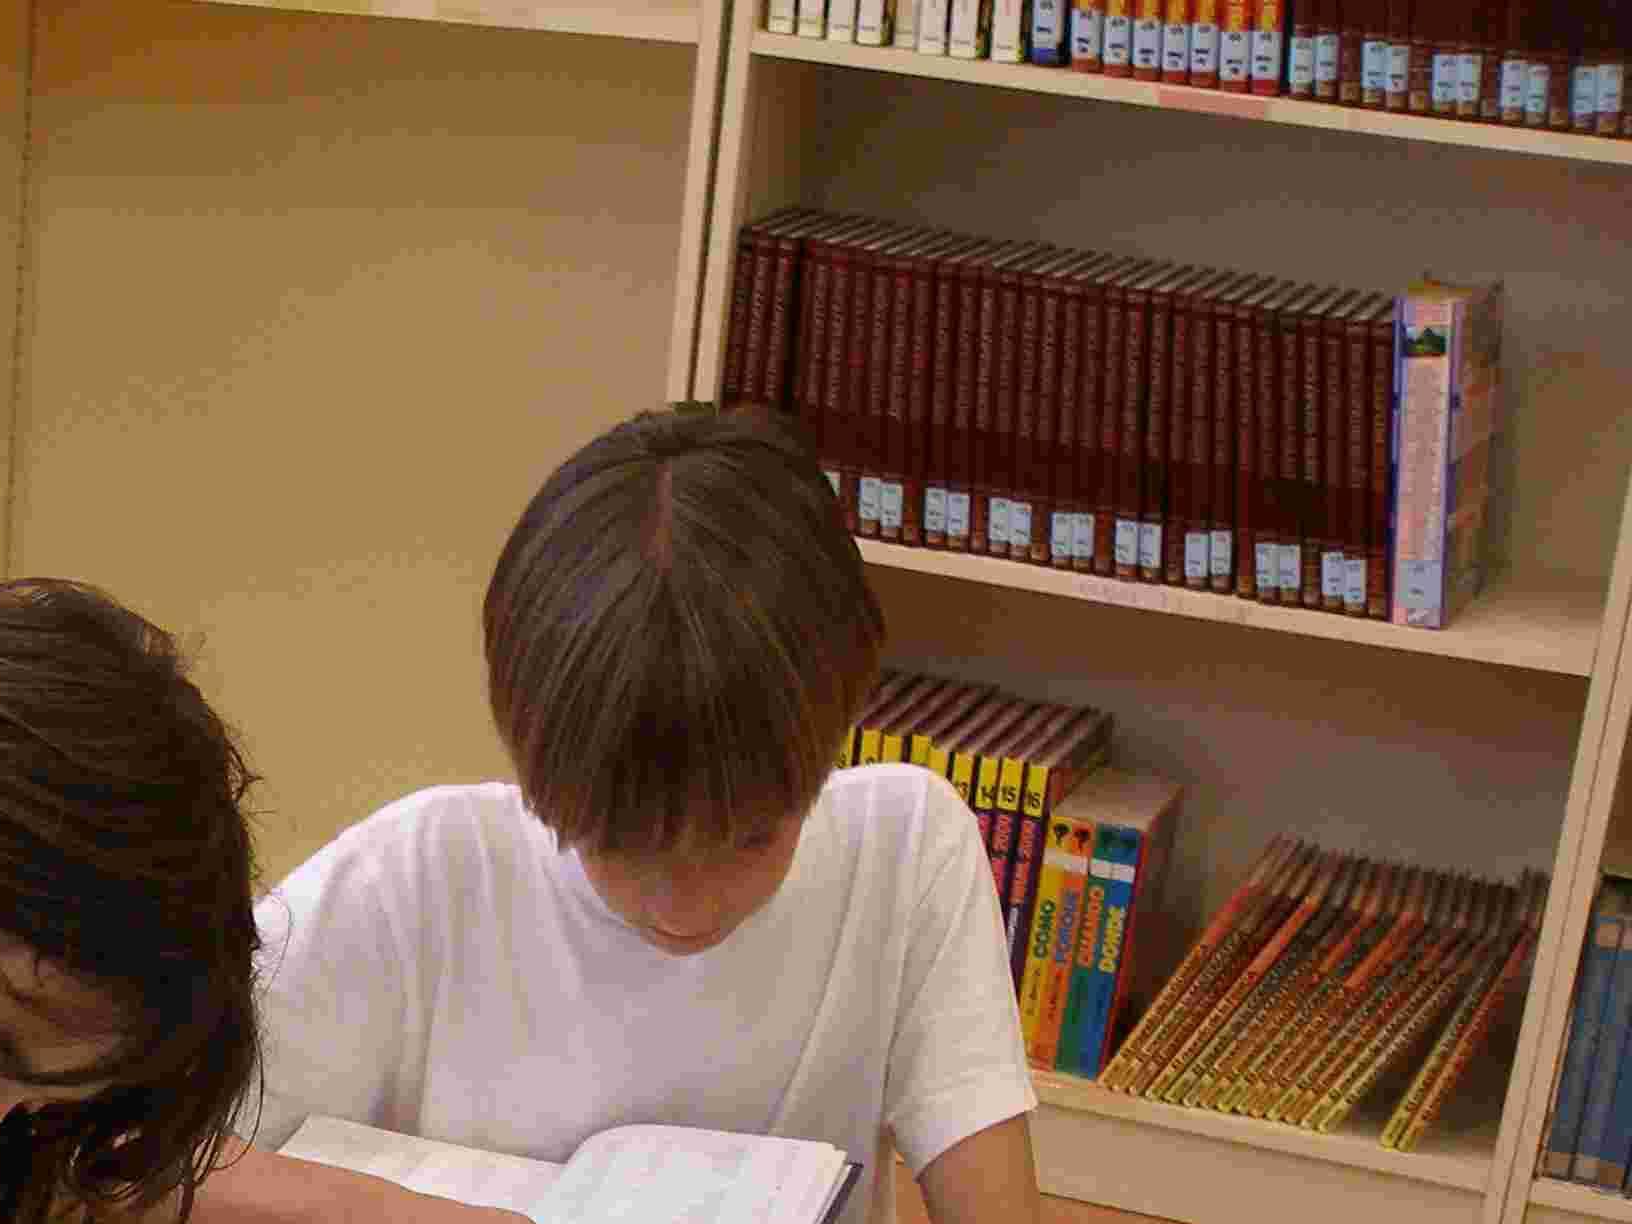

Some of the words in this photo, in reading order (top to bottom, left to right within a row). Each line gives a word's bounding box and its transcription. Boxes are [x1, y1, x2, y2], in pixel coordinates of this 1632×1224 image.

[1001, 785, 1017, 803] 15
[1033, 899, 1057, 960] COMO
[1099, 906, 1126, 973] DONDE
